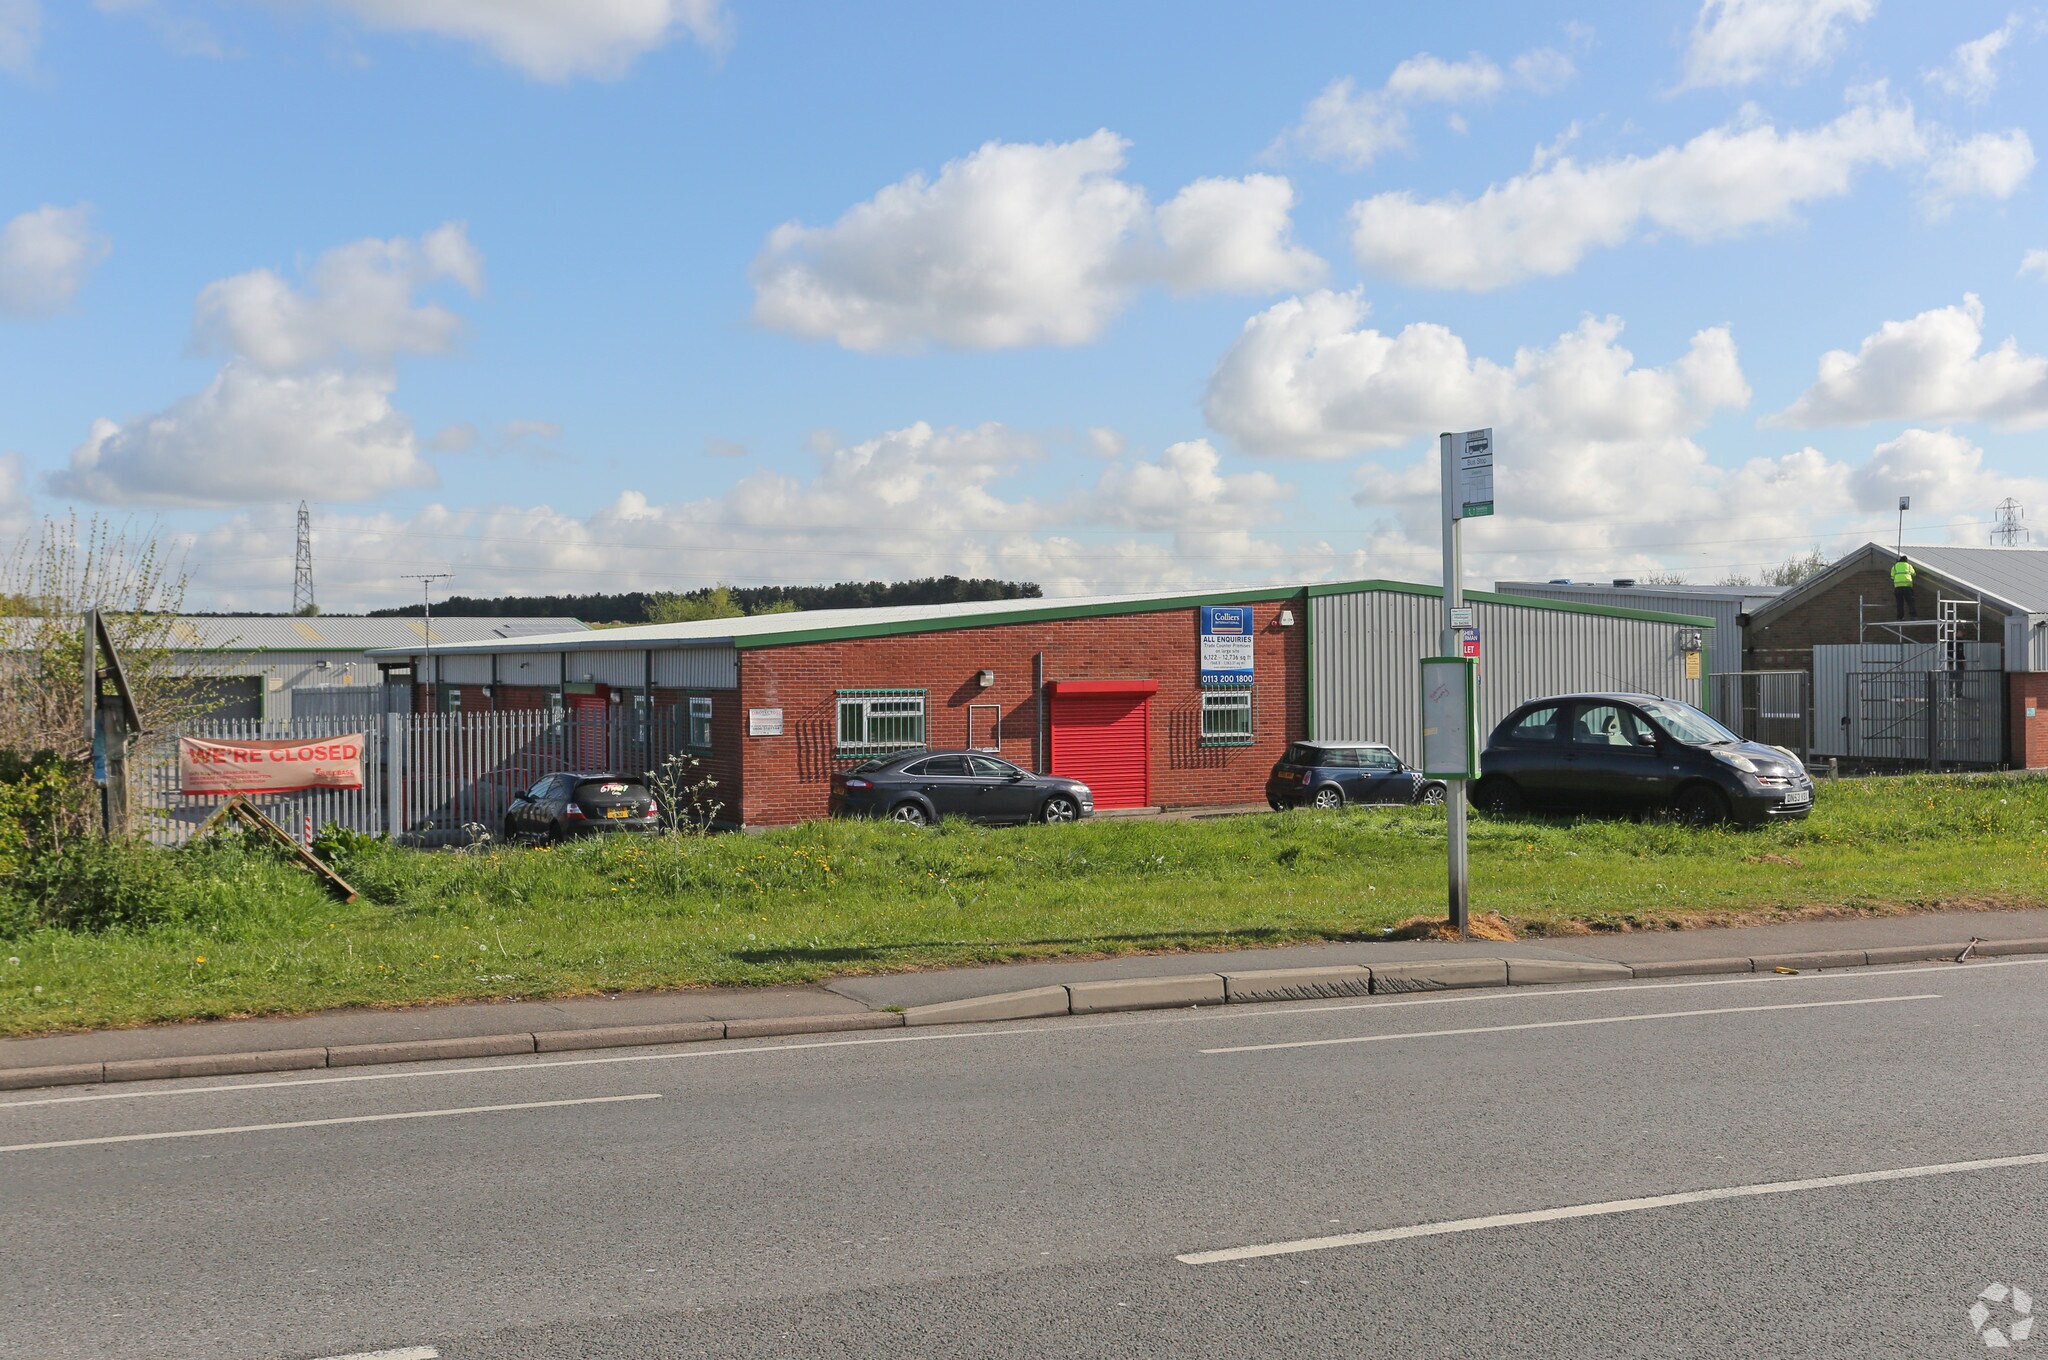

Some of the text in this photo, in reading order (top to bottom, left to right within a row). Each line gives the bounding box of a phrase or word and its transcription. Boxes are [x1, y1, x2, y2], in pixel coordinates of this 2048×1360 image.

[1214, 612, 1240, 621] Colliers
[1464, 645, 1475, 654] LET
[1202, 675, 1253, 683] 0113 200 1800
[269, 745, 357, 763] CLOSED
